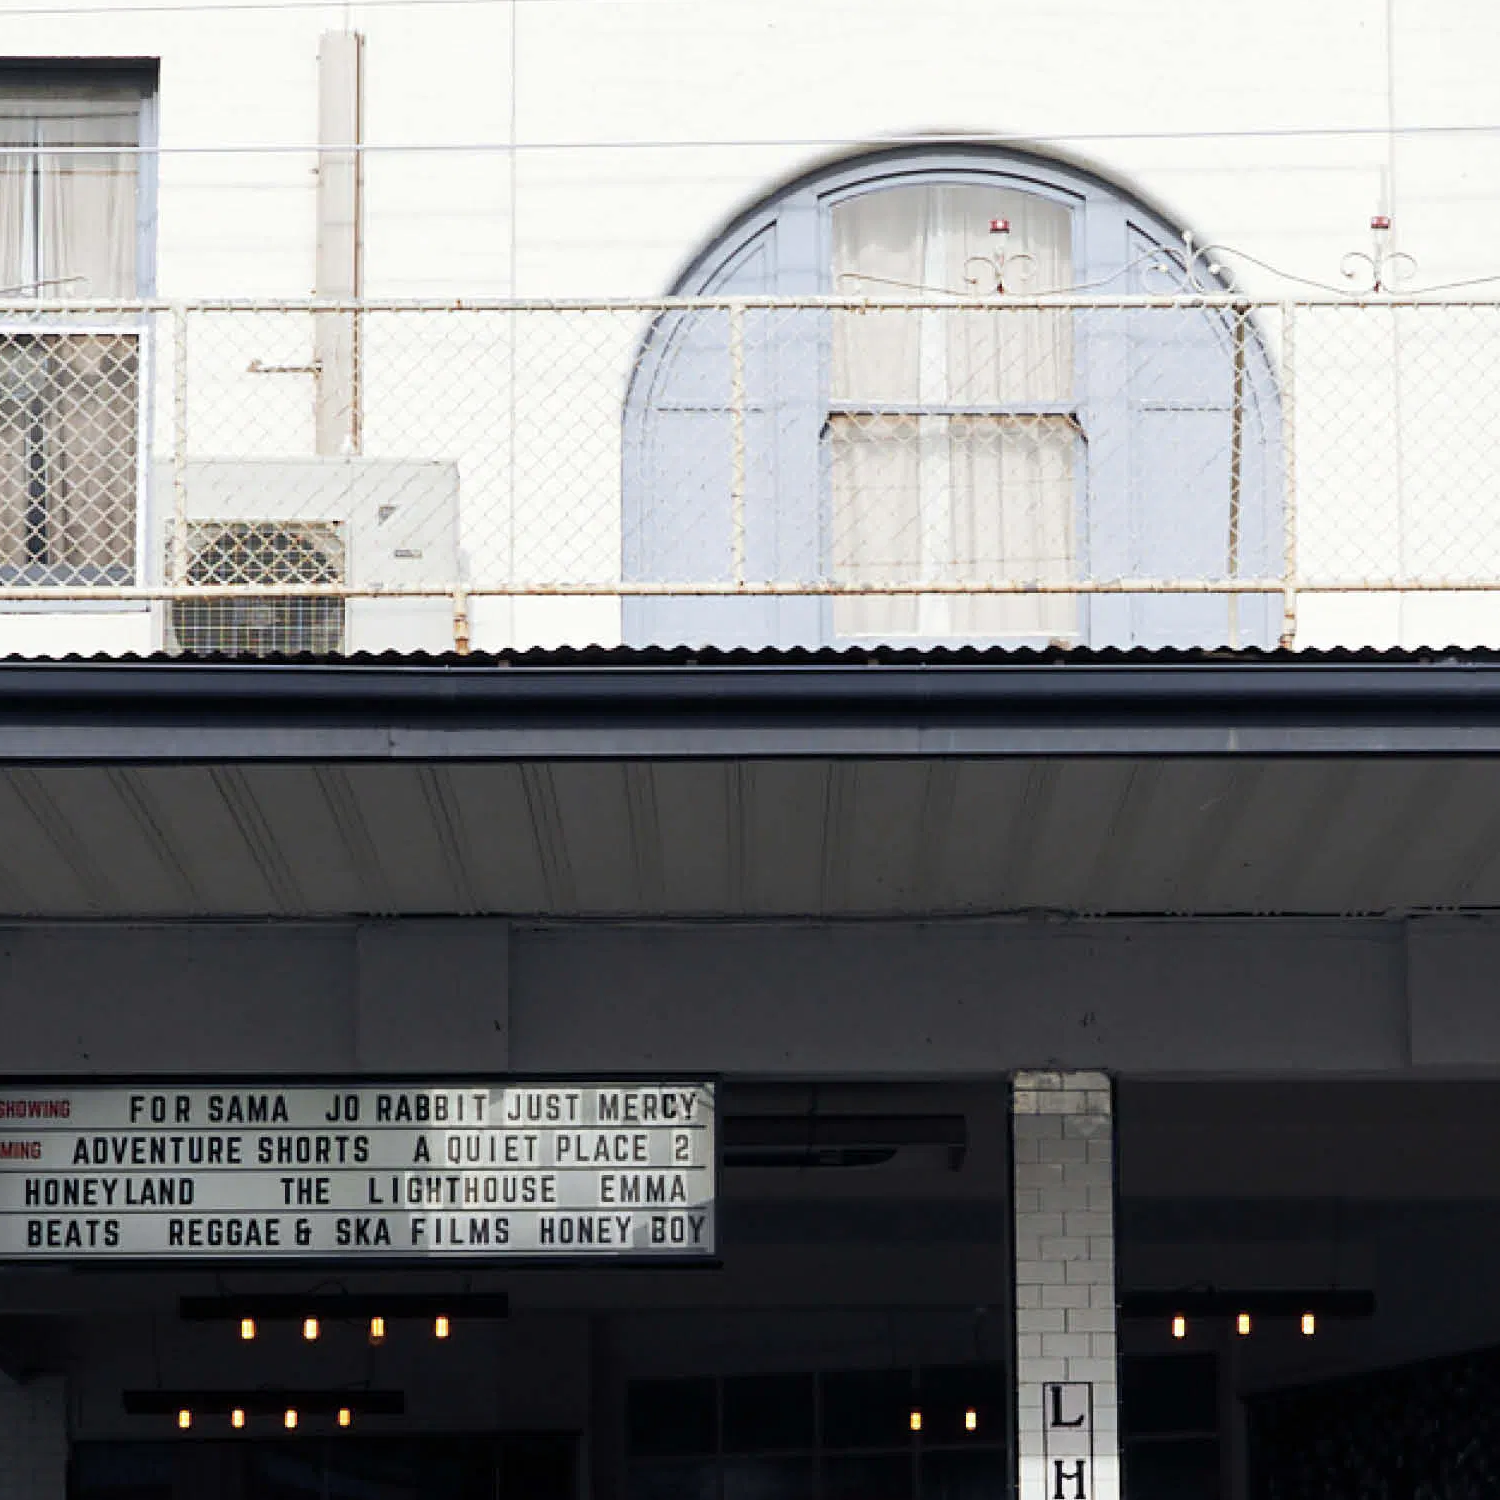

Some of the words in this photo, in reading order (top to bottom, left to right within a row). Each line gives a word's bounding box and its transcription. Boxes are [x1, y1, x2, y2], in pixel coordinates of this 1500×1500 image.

[129, 1095, 191, 1123] FOR
[207, 1095, 289, 1123] SAMA
[325, 1094, 360, 1122] JO
[376, 1093, 487, 1122] RABBIT
[507, 1093, 580, 1122] JUST
[599, 1092, 696, 1121] MERCY
[72, 1136, 243, 1165] ADVENTURE
[257, 1135, 370, 1164] SHORTS
[413, 1135, 432, 1163] A
[447, 1134, 538, 1164] QUIET
[555, 1134, 648, 1163] PLACE
[674, 1134, 690, 1162] 2
[24, 1177, 195, 1206] HONEYLAND
[280, 1177, 331, 1205] THE
[368, 1175, 557, 1205] LIGHTHOUSE
[600, 1174, 687, 1203] EMMA
[27, 1219, 120, 1247] BEATS
[168, 1218, 281, 1246] REGGAE
[295, 1218, 312, 1246] &
[336, 1218, 391, 1246] SKA
[411, 1217, 510, 1245] FILMS
[540, 1215, 632, 1244] HONEY
[651, 1215, 705, 1244] BOY
